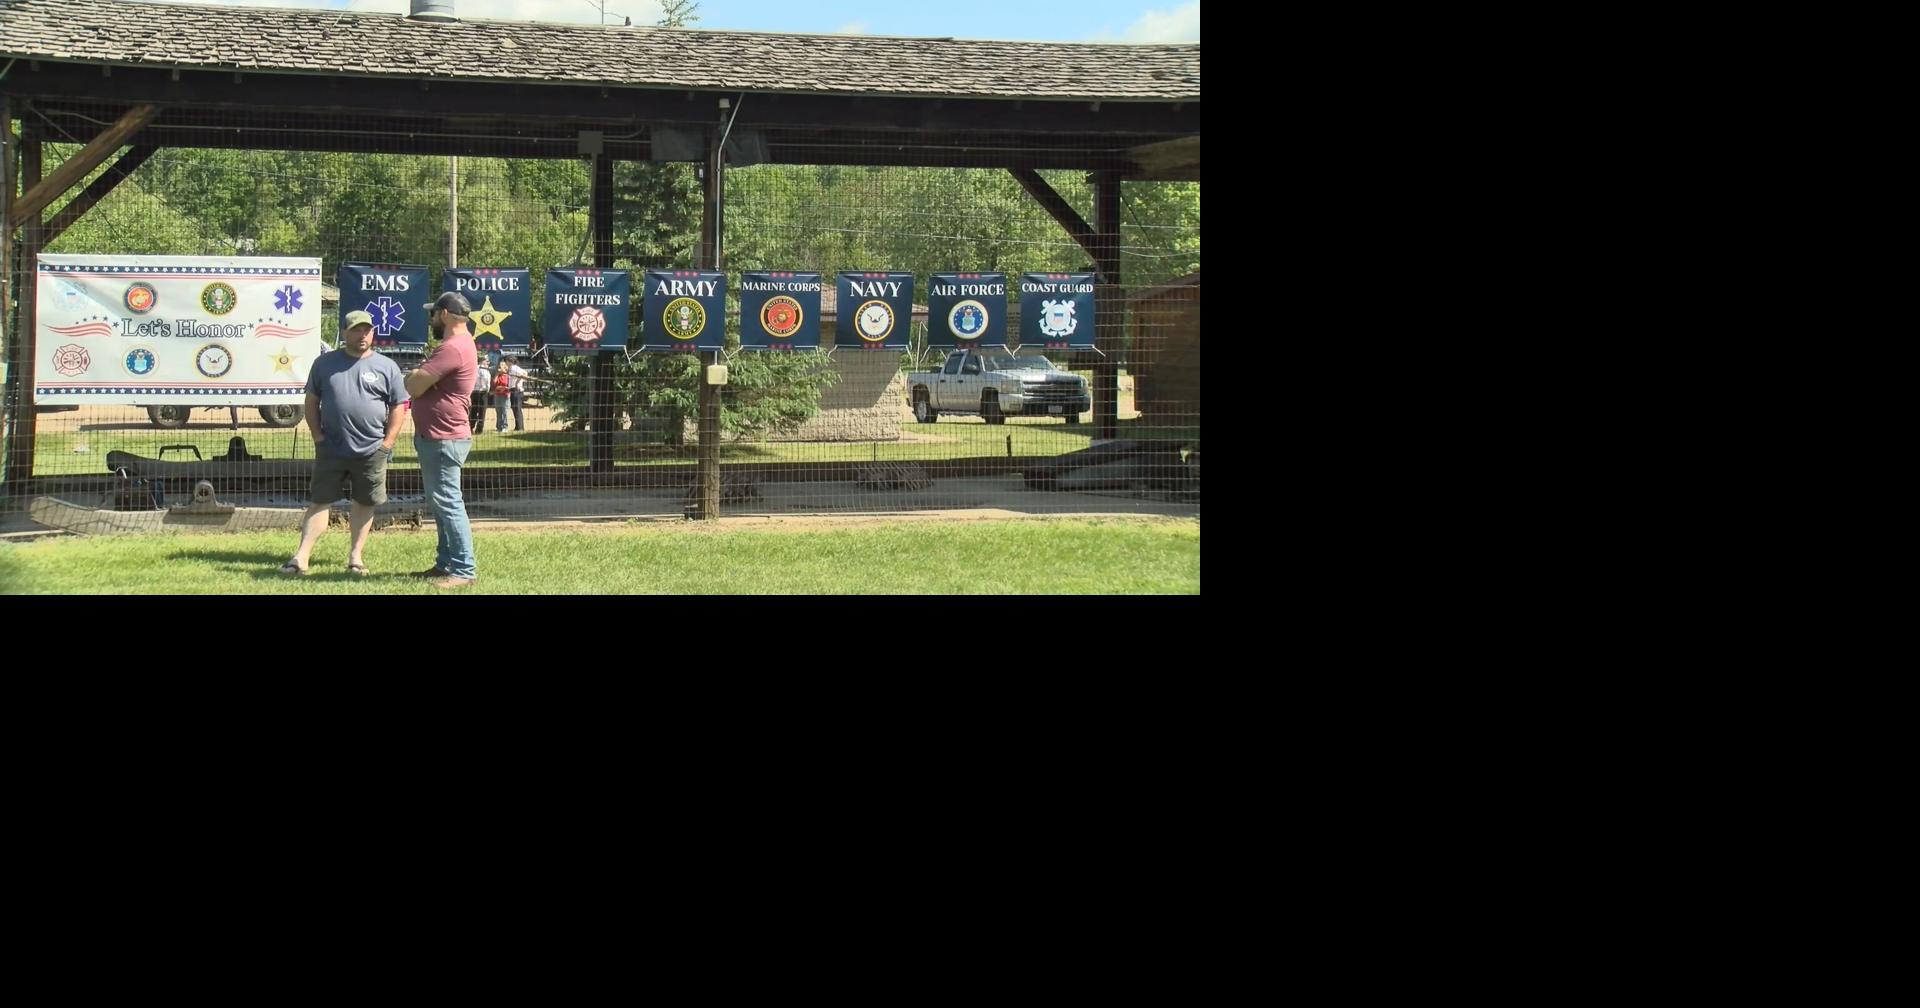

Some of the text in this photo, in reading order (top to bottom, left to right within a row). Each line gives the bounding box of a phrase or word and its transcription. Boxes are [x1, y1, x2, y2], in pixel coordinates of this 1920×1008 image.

[361, 274, 410, 292] EMS
[456, 277, 520, 292] POLICE
[574, 276, 605, 288] FIRE
[654, 279, 718, 298] ARMY
[742, 281, 821, 293] MARINE CORPS
[1021, 282, 1094, 294] COAST GUARD
[850, 281, 903, 298] NAVY
[931, 283, 1005, 297] AIR FORCE
[555, 293, 621, 306] FIGHTERS
[121, 318, 246, 338] Let's Honor
